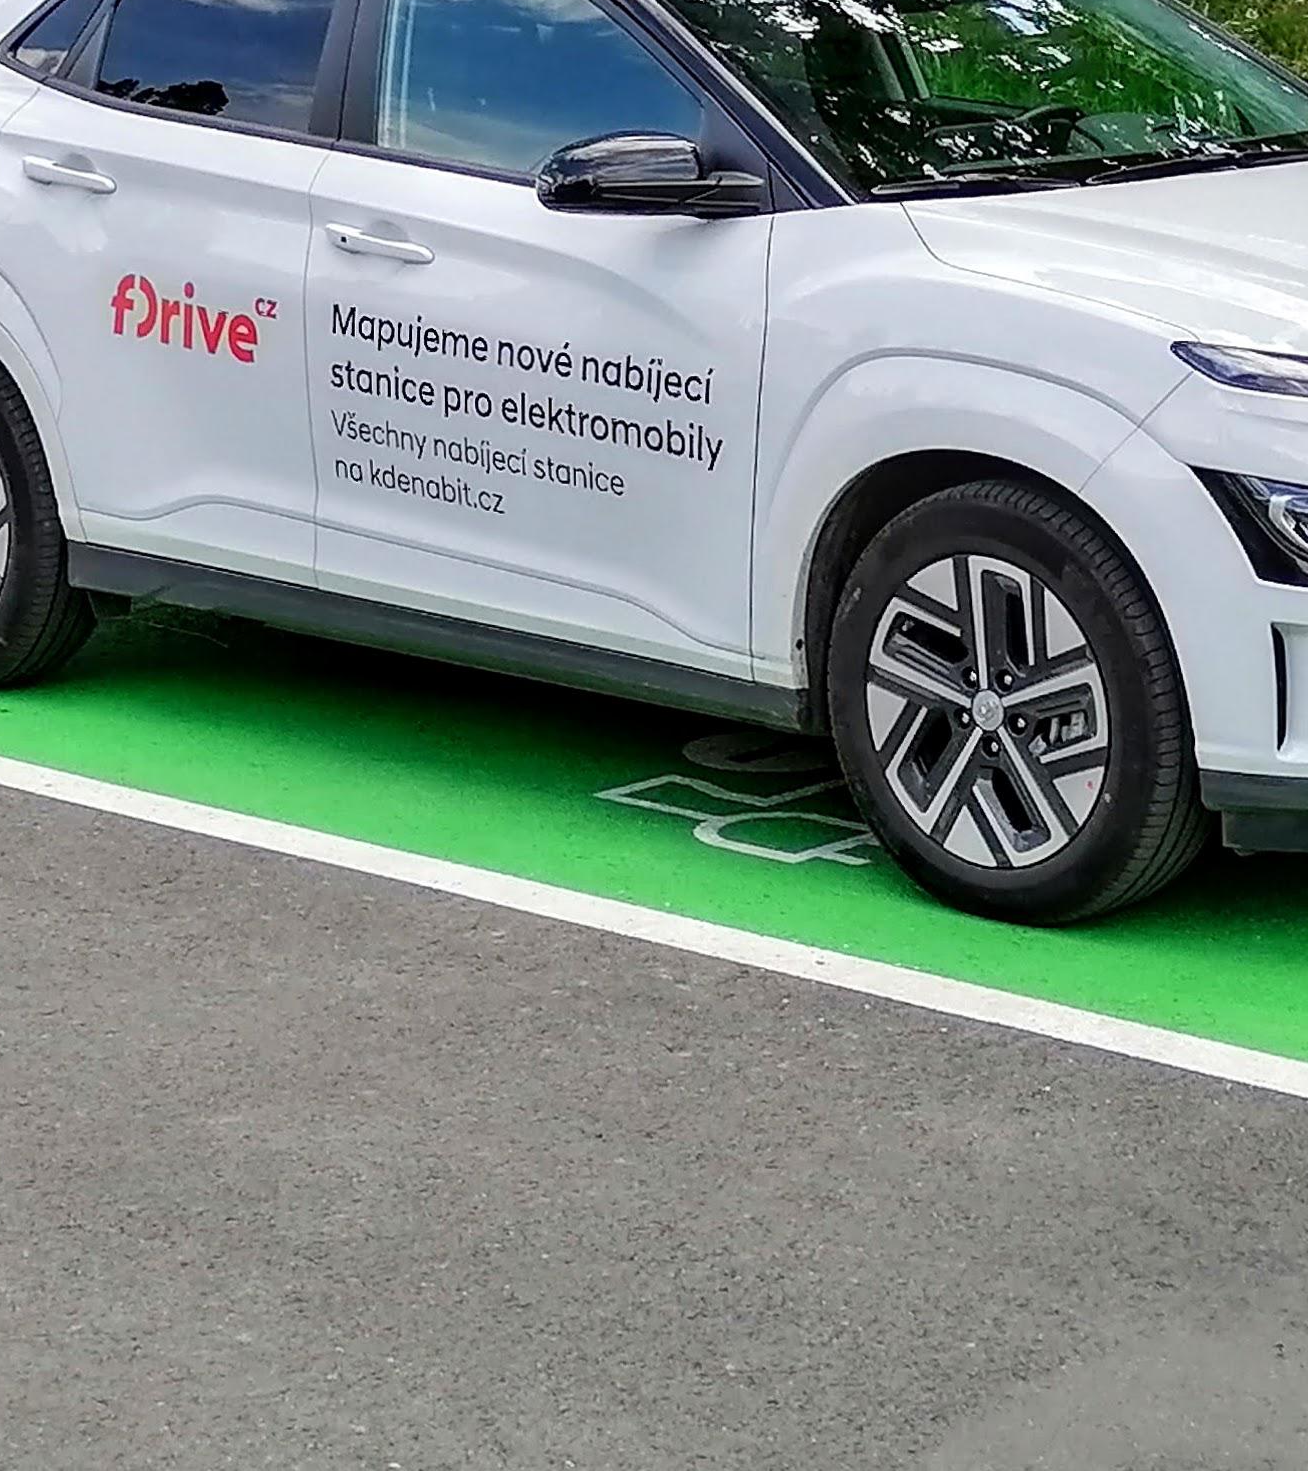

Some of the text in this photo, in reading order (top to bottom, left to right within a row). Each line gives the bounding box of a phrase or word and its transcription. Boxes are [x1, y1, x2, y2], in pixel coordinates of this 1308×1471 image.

[331, 303, 714, 405] Mapujeme nové nabíjecí
[330, 360, 724, 472] stanice pro elektromobily
[331, 408, 625, 496] Všechny nabíjecí stanice
[335, 458, 506, 515] na kdenabit.cz
